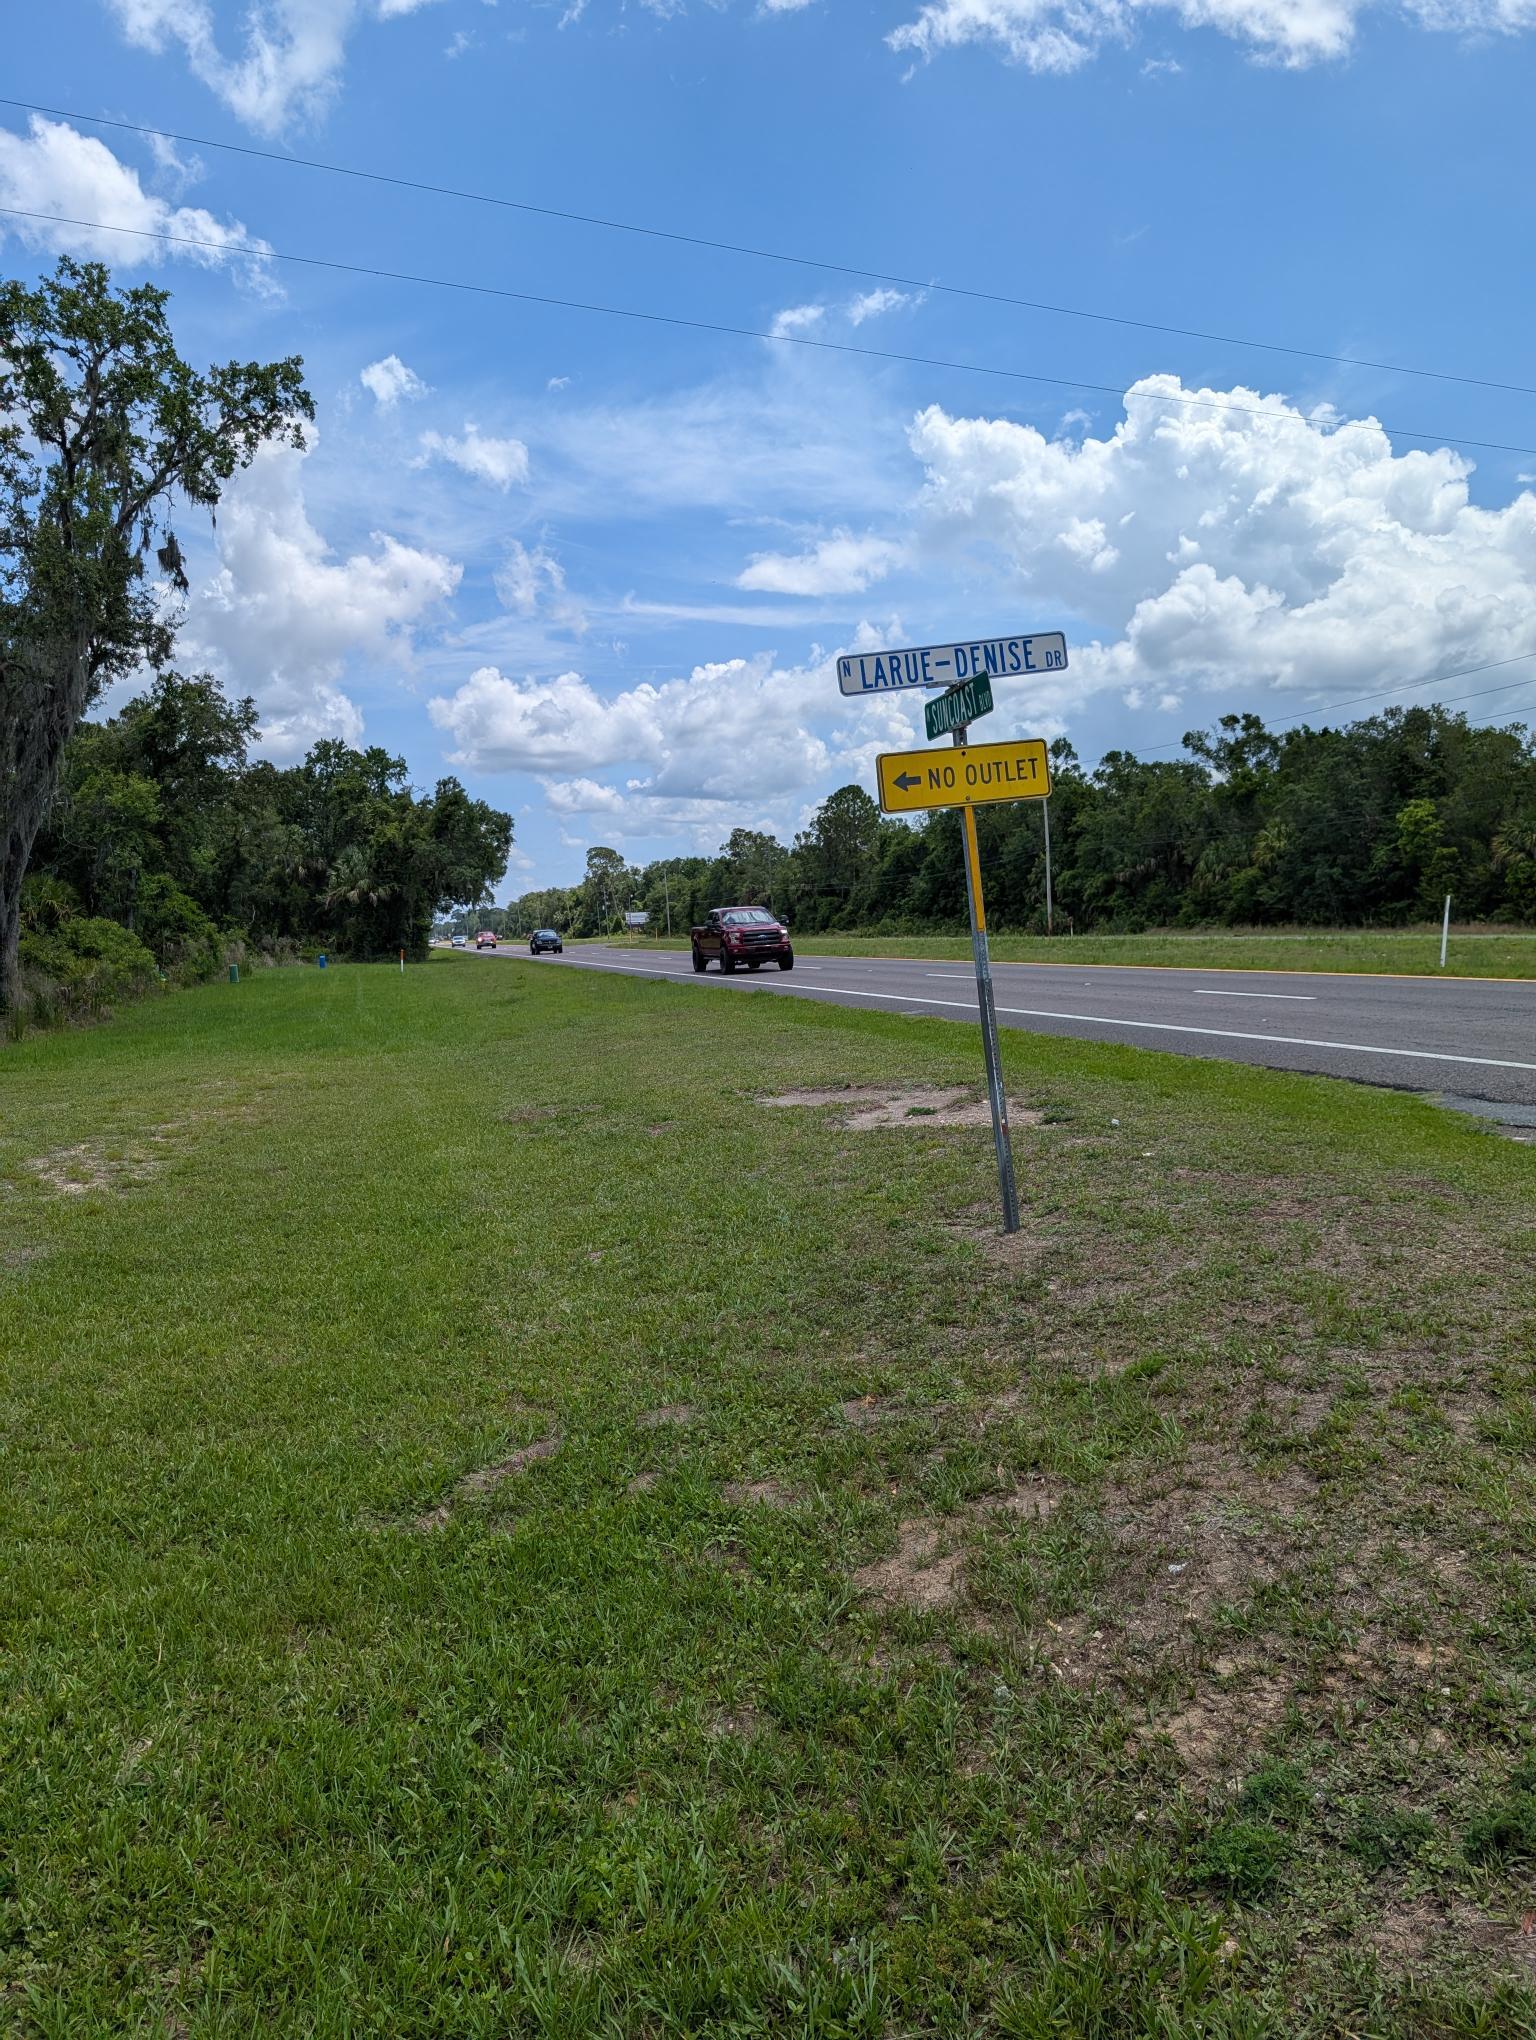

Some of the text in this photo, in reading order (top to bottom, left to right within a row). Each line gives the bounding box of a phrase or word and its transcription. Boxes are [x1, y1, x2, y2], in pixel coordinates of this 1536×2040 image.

[842, 639, 1062, 689] N LARUE-DENISE DR
[931, 682, 977, 734] SUNCOAST
[928, 758, 1038, 790] NO OUTLET
